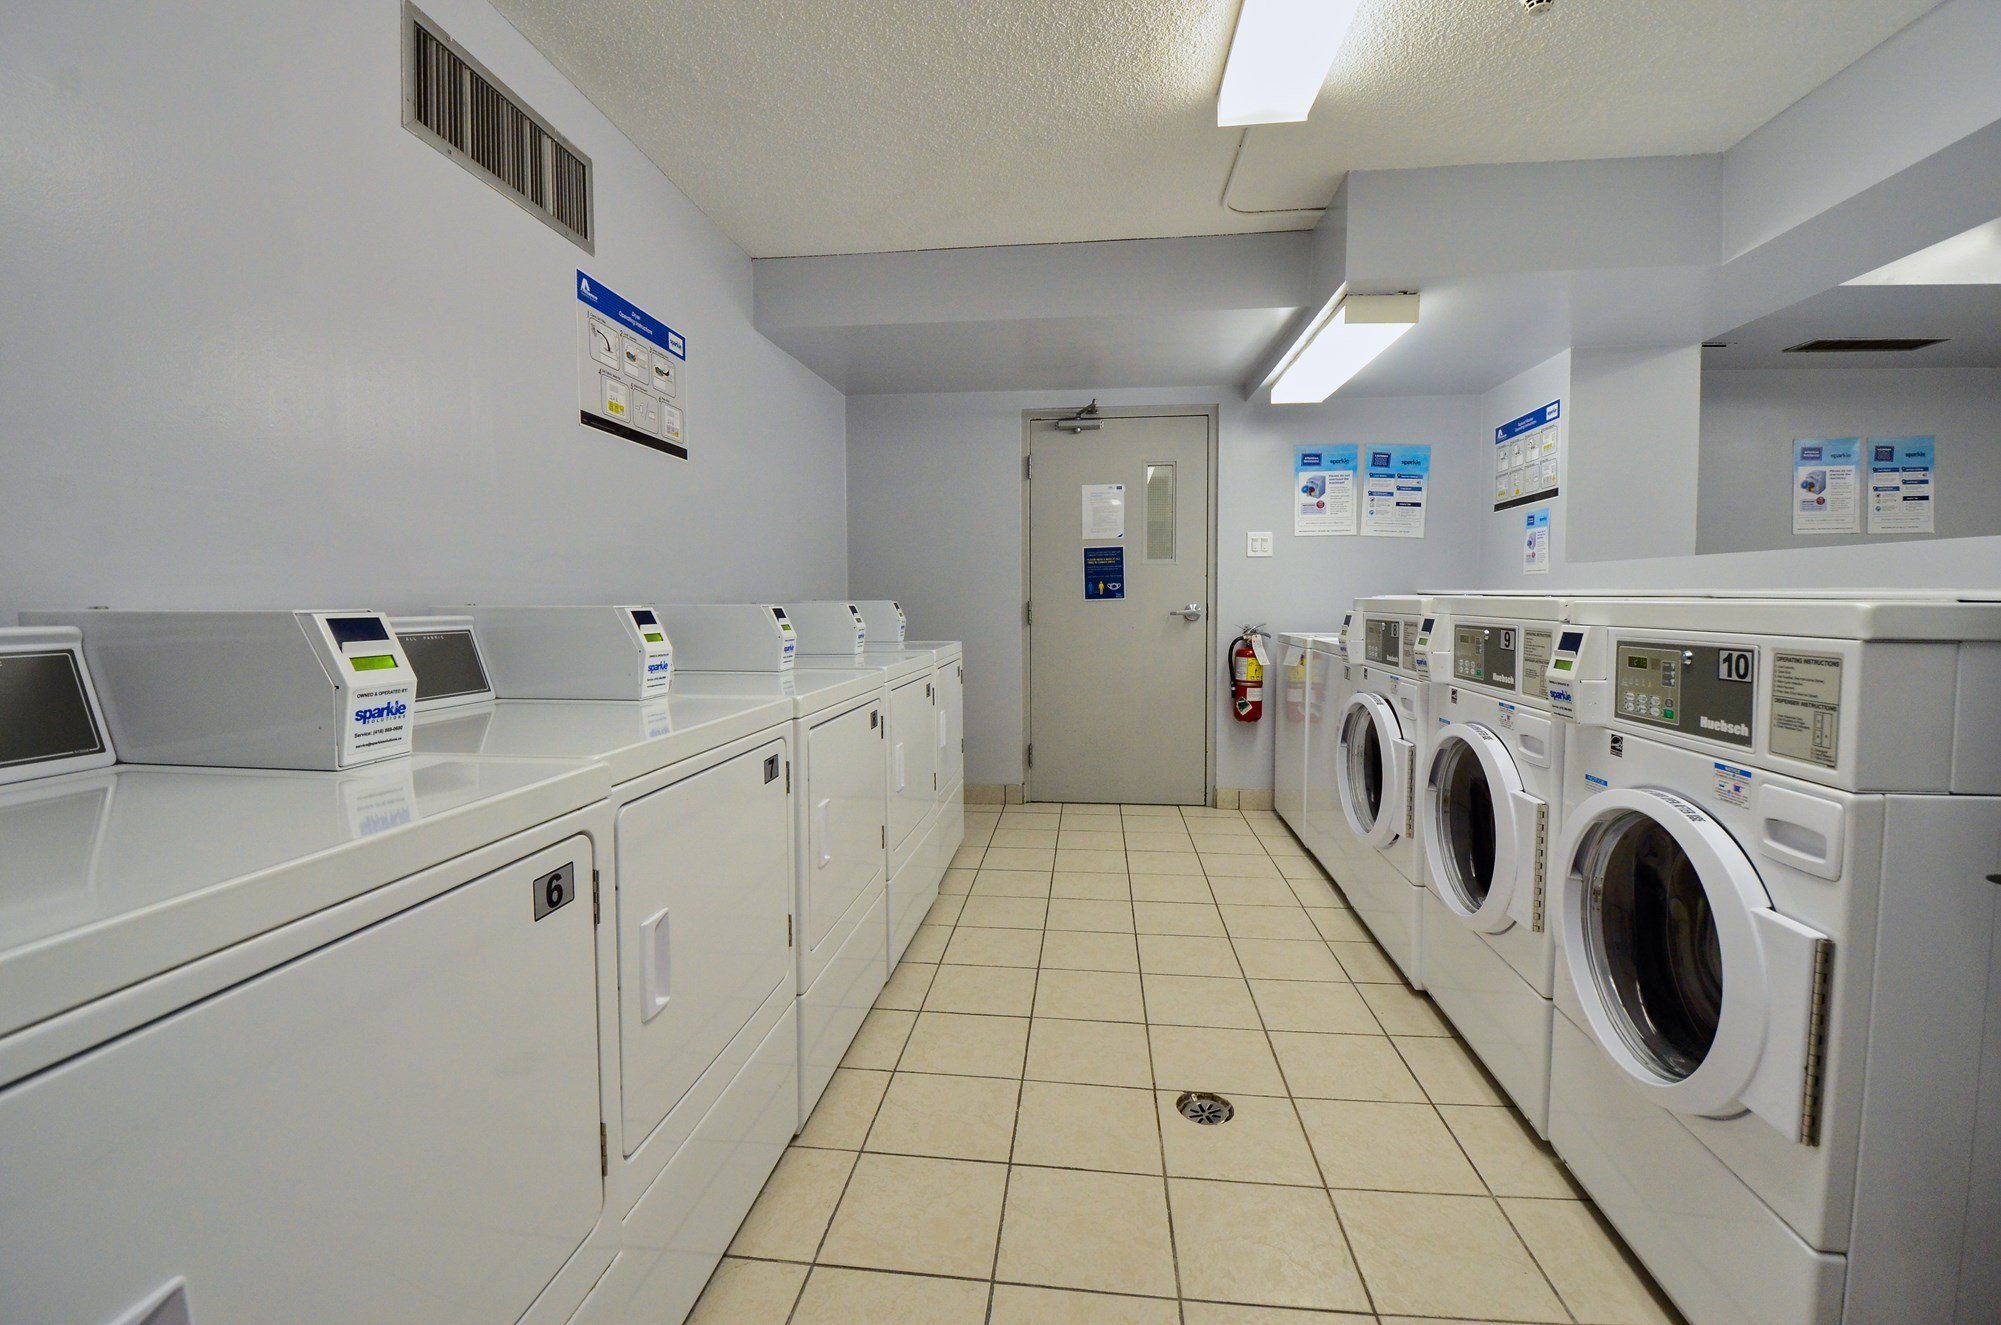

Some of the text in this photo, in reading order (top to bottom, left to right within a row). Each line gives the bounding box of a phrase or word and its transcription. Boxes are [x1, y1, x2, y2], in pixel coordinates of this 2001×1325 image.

[1392, 624, 1398, 636] 8
[1504, 631, 1511, 648] 9
[1722, 652, 1749, 680] 10
[1776, 656, 1840, 667] OPERATING INSTRUCTIONS
[1774, 697, 1837, 712] DISPENSER INSTRUCTIONS
[367, 714, 406, 724] SOLUTIONS
[1700, 715, 1749, 737] Huebsch
[768, 758, 776, 778] 7
[545, 872, 564, 909] 6
